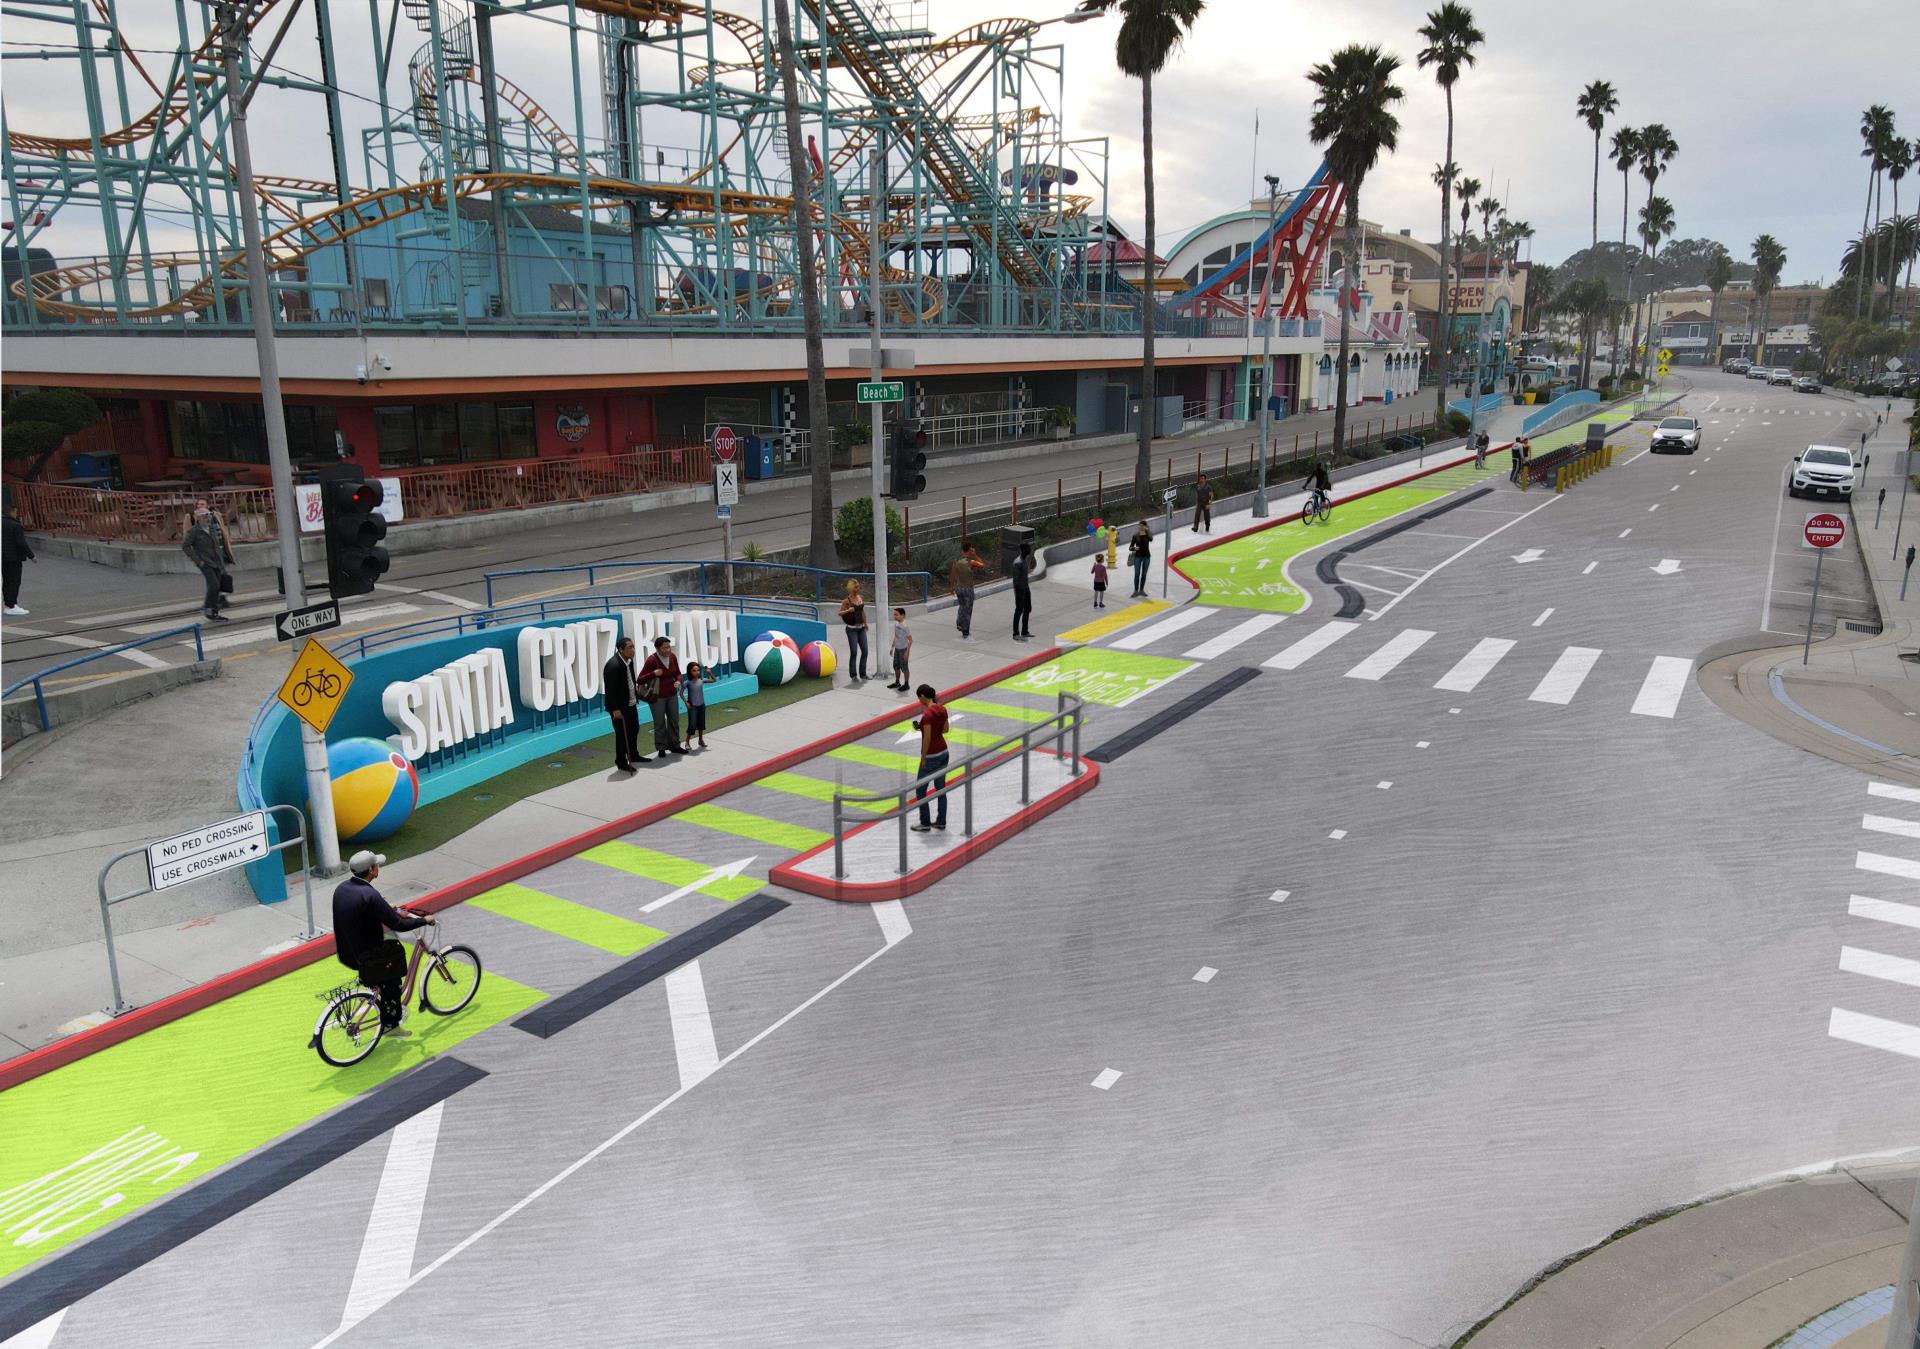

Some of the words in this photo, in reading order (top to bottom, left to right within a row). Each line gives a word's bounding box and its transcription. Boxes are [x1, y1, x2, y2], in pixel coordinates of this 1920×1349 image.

[1448, 287, 1485, 297] OPEN
[863, 386, 888, 399] Beach
[716, 438, 735, 450] STOP
[1811, 534, 1835, 542] ENTER
[291, 615, 311, 630] ONE
[314, 609, 333, 624] WAY
[382, 648, 515, 761] SANTA
[518, 618, 618, 711] CRUZ
[622, 609, 739, 679] BEACH
[163, 844, 178, 857] NO
[181, 837, 202, 852] PED
[206, 821, 254, 844] CROSSING
[162, 867, 183, 881] USE
[186, 846, 246, 873] CROSSWALK
